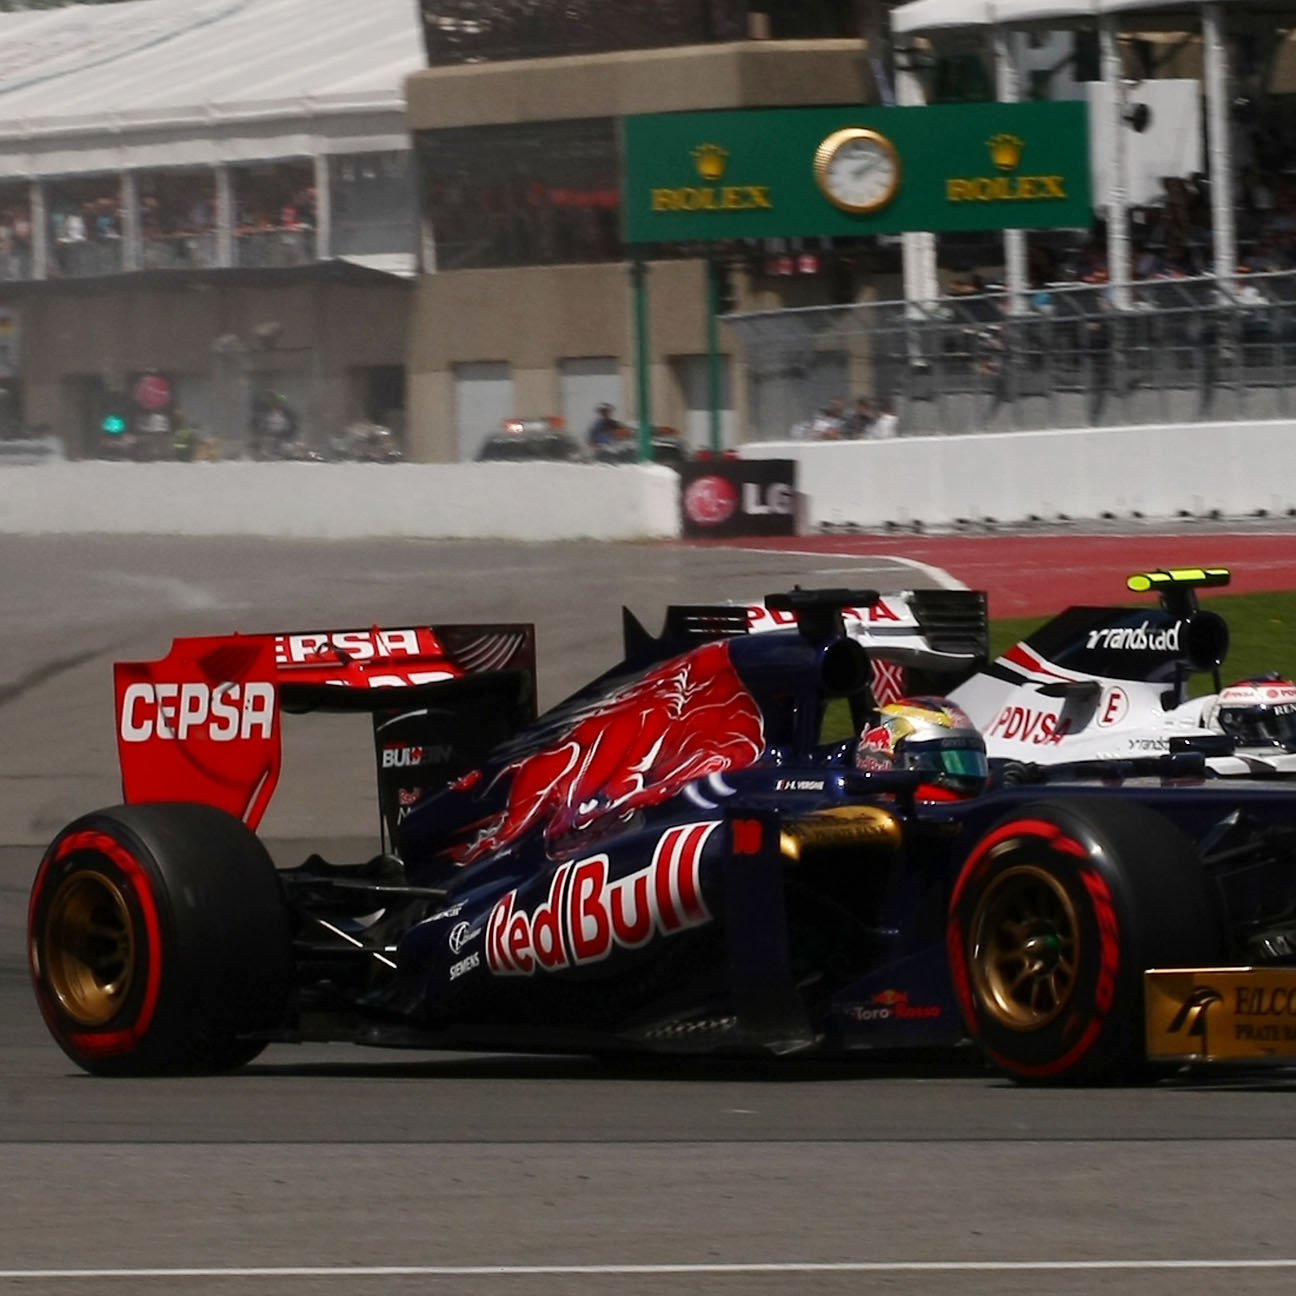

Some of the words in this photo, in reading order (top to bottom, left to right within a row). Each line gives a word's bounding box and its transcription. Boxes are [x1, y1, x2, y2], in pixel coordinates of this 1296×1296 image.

[650, 186, 772, 211] ROLEX
[946, 175, 1067, 201] ROLEX
[742, 481, 795, 515] LG
[1086, 620, 1182, 651] randstad
[121, 682, 275, 742] CEPSA
[988, 705, 1073, 746] PDVSA
[485, 860, 574, 976] Red
[567, 819, 724, 966] Bull
[850, 1005, 890, 1021] Toro
